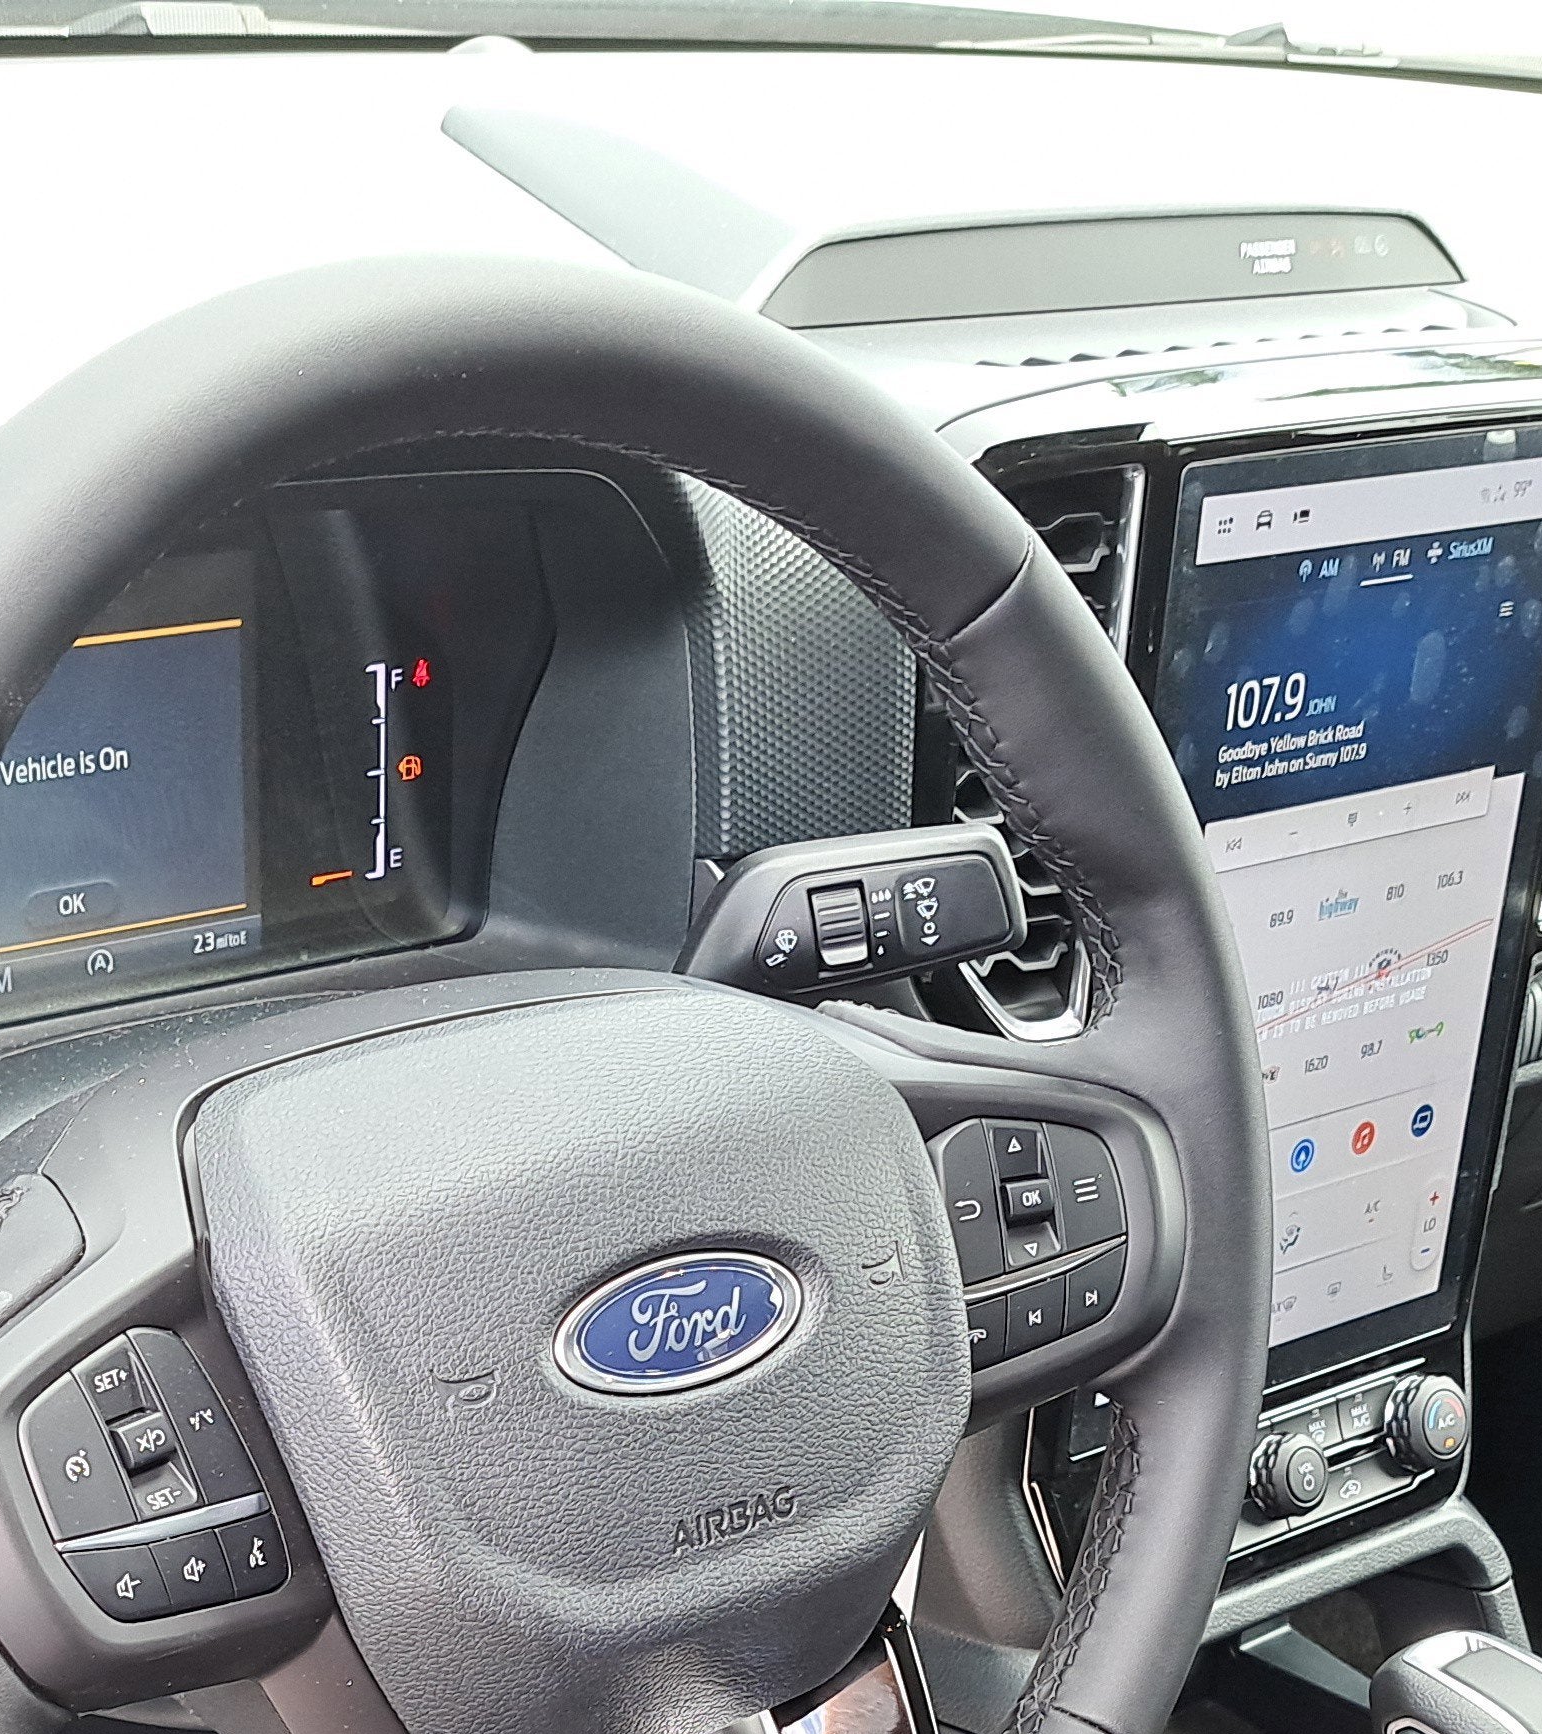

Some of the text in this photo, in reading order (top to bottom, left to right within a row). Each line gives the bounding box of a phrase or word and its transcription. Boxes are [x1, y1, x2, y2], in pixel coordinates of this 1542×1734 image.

[1391, 548, 1411, 568] FM
[1447, 537, 1495, 560] SiriusXM
[1318, 558, 1341, 579] AM
[390, 668, 403, 691] F
[1226, 672, 1338, 731] 107.9 JOHN
[1218, 720, 1365, 764] Goodbye Yellow Brick Road
[0, 752, 76, 786] Vehicle
[99, 746, 129, 771] On
[1214, 742, 1367, 790] by Elton John on Sunny 107.9
[389, 847, 403, 869] E
[1386, 883, 1405, 901] 810
[59, 893, 86, 916] OK
[1269, 909, 1294, 928] 89.9
[192, 931, 215, 954] 23
[1021, 1190, 1042, 1208] OK
[627, 1280, 747, 1363] Ford
[669, 1486, 797, 1556] AIRBAG
